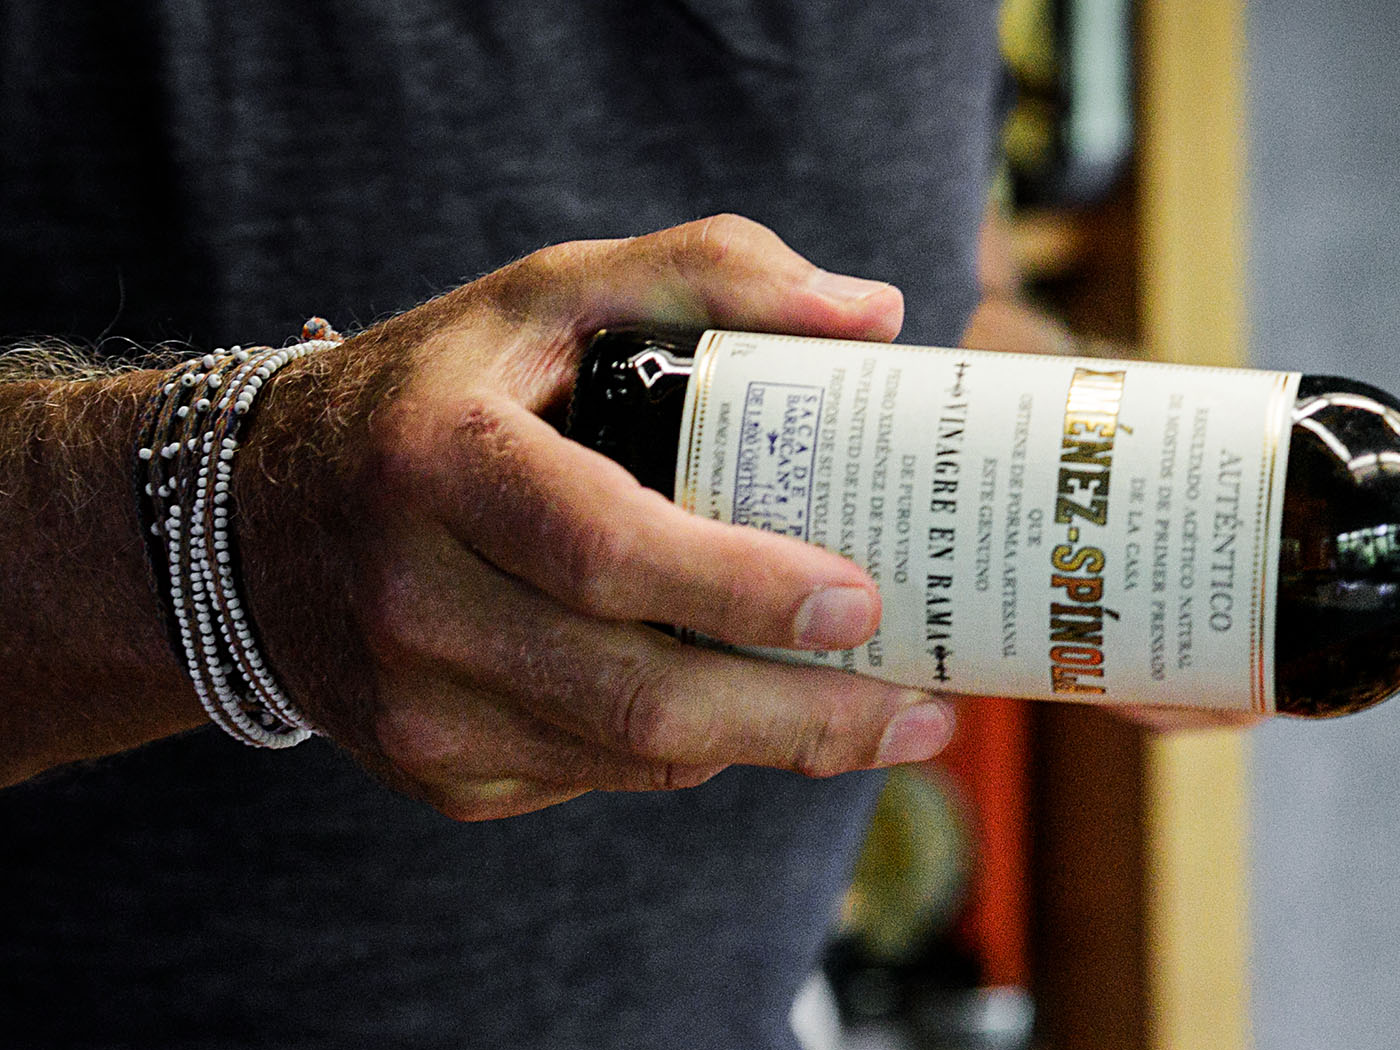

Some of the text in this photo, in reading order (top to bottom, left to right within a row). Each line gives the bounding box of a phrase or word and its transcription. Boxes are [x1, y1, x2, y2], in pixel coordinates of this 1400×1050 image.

[750, 387, 766, 406] DE
[795, 395, 818, 454] SACA
[778, 394, 801, 466] BARRICA
[820, 428, 837, 451] DE
[871, 412, 893, 491] XIMÉNEZ
[1159, 415, 1180, 480] MOSTOS
[738, 448, 758, 526] OBTENID
[791, 466, 807, 498] DE
[817, 455, 834, 478] SU
[843, 462, 860, 487] DE
[1007, 464, 1026, 490] DE
[1157, 486, 1172, 511] DE
[813, 480, 831, 549] EVOLU
[841, 491, 857, 526] LOS
[869, 496, 885, 521] DE
[894, 454, 917, 583] DE PURO VINO
[926, 403, 972, 643] VINAGRE EN RAMA
[975, 458, 999, 592] ESTE GENUINO
[1004, 493, 1023, 559] FORMA
[1026, 508, 1044, 547] QUE
[1124, 478, 1146, 590] DE LA CASA
[1208, 448, 1244, 632] AUTÉNTICO
[1151, 519, 1170, 593] PRIMER
[1179, 507, 1201, 589] ACÉTICO
[1150, 600, 1167, 681] PRENSADO
